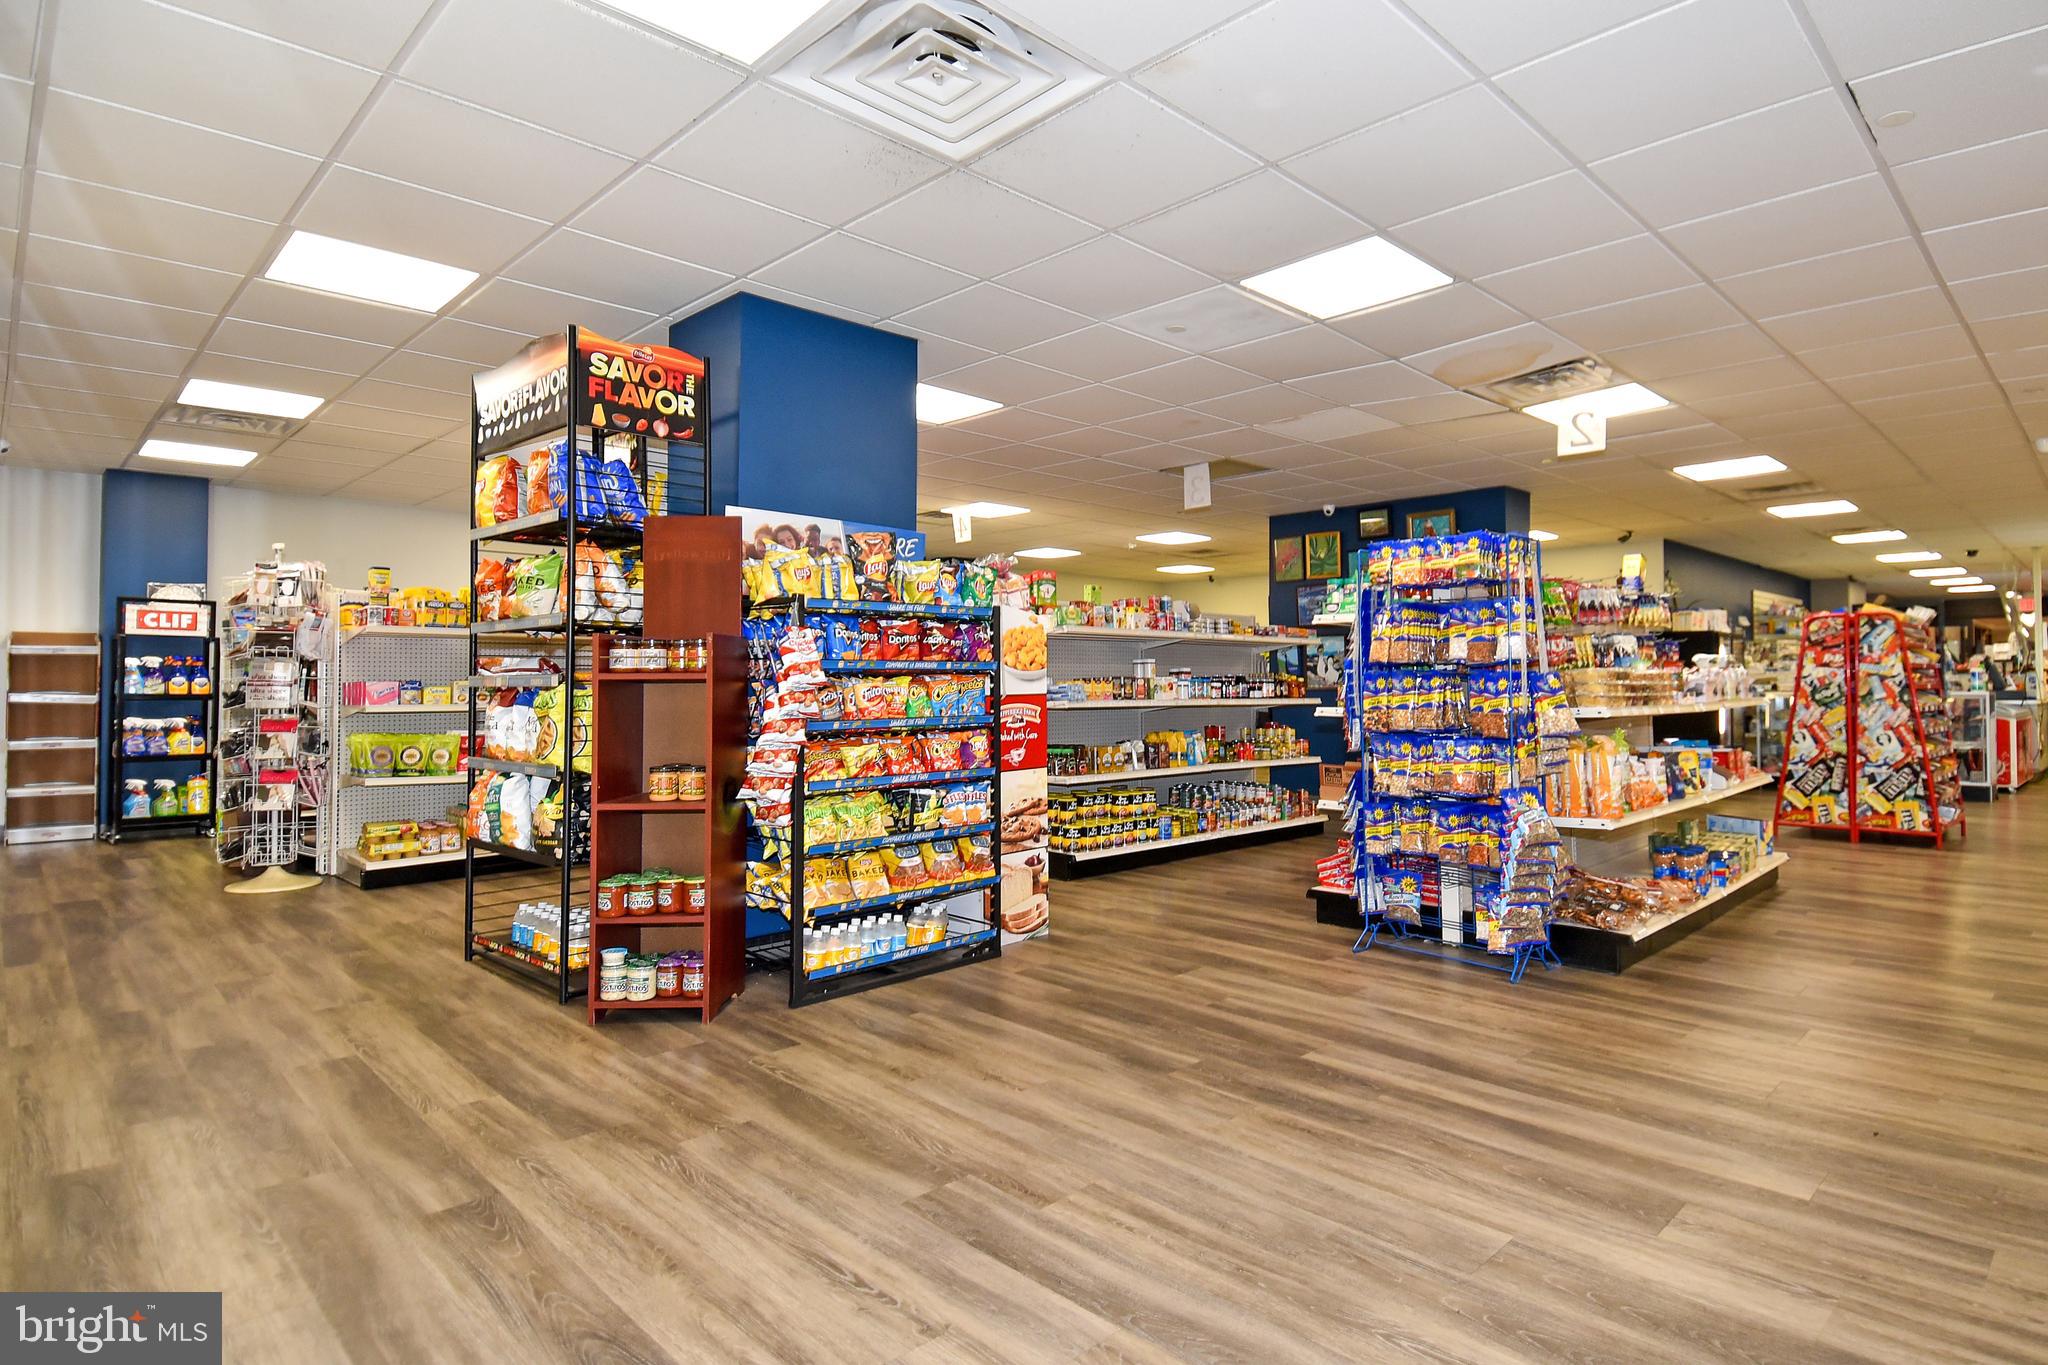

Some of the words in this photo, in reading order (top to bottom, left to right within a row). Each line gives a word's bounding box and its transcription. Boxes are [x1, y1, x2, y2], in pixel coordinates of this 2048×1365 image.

[588, 352, 684, 394] SAVOR
[685, 374, 695, 395] THE
[479, 395, 518, 426] SAVOR
[522, 366, 568, 409] FLAVOR
[588, 375, 696, 419] FLAVOR
[794, 566, 811, 581] Lay's
[143, 613, 192, 629] CLIF
[888, 635, 917, 644] Doritos
[851, 865, 885, 879] BAKED
